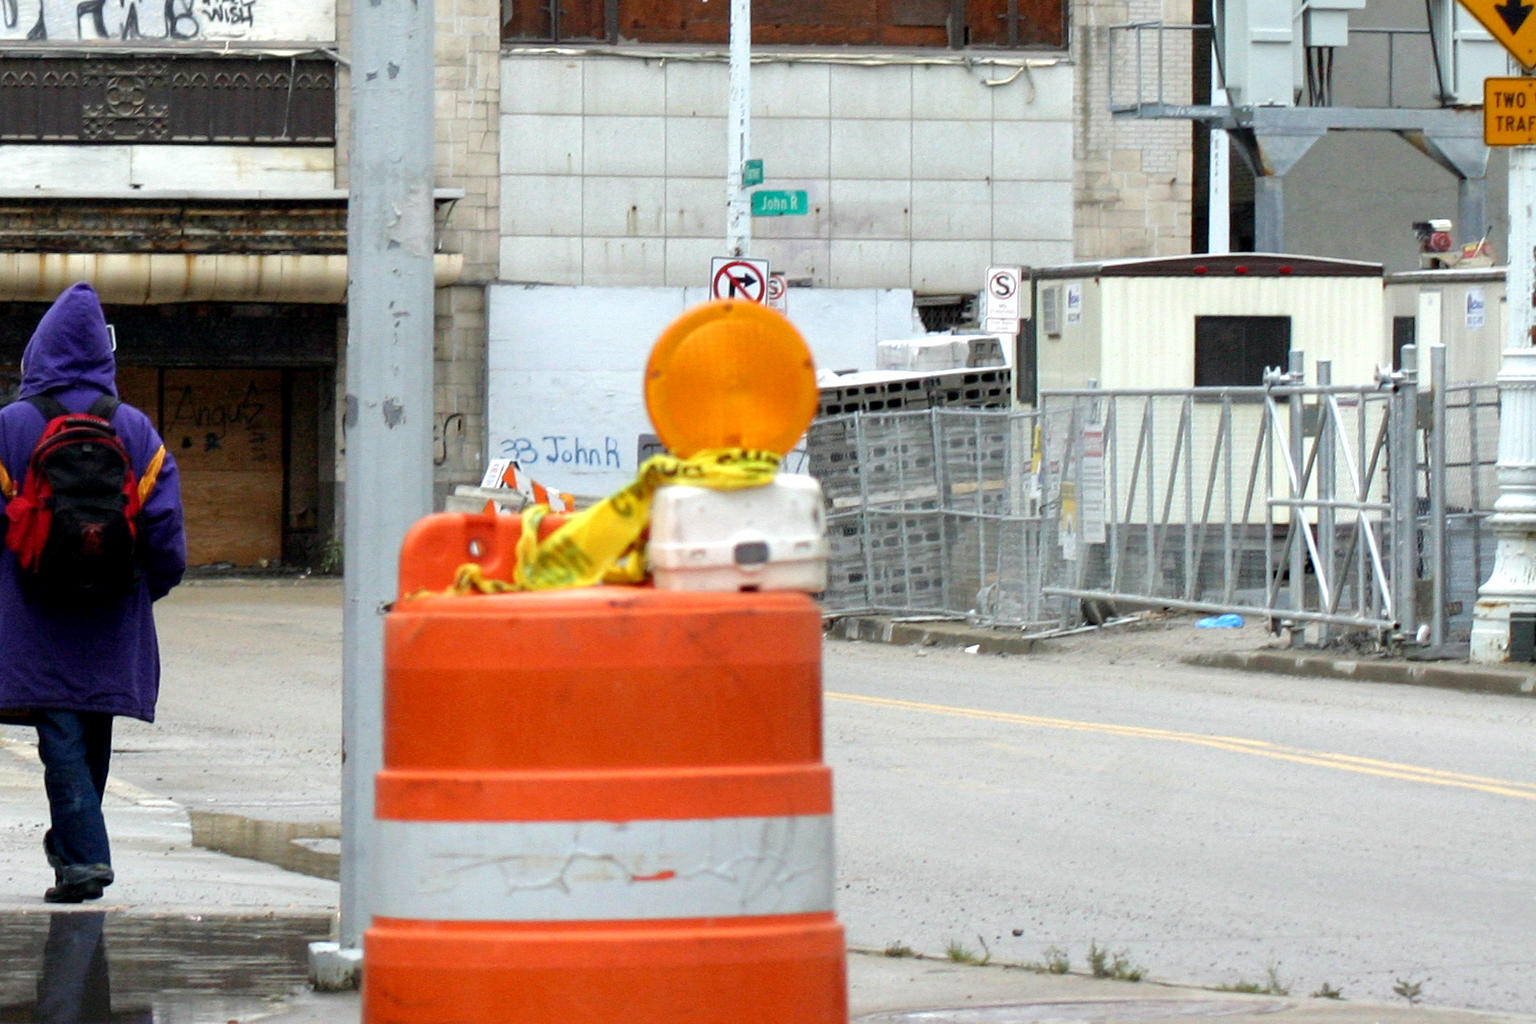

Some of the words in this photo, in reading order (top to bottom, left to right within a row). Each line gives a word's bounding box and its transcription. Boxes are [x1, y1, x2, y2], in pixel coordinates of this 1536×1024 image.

[1494, 92, 1526, 109] TWO
[1495, 115, 1536, 132] TRAF
[761, 196, 787, 210] John
[790, 193, 798, 210] R
